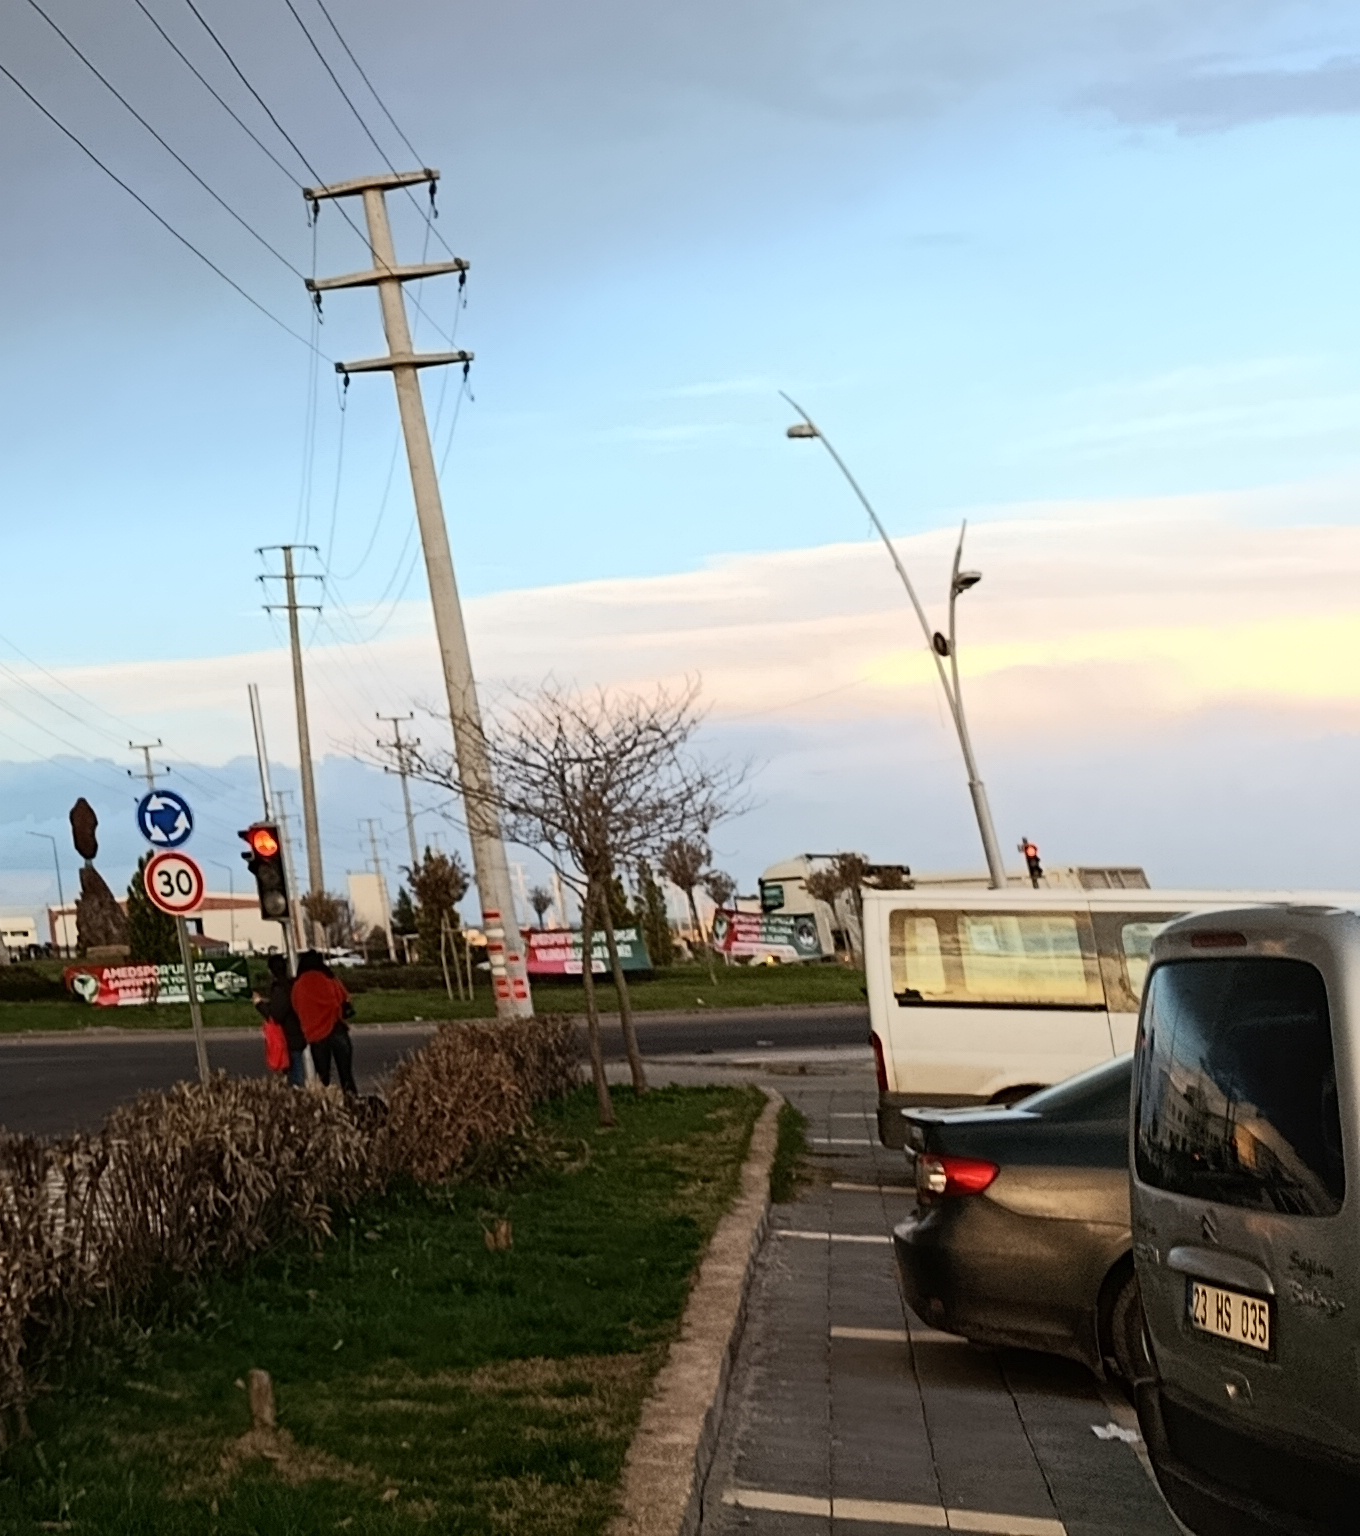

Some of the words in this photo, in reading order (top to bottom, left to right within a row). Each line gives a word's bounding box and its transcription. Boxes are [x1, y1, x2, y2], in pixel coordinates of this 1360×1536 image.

[158, 869, 192, 897] 30
[1193, 1287, 1208, 1326] 23
[1216, 1292, 1232, 1333] HS
[1241, 1300, 1267, 1344] 035
